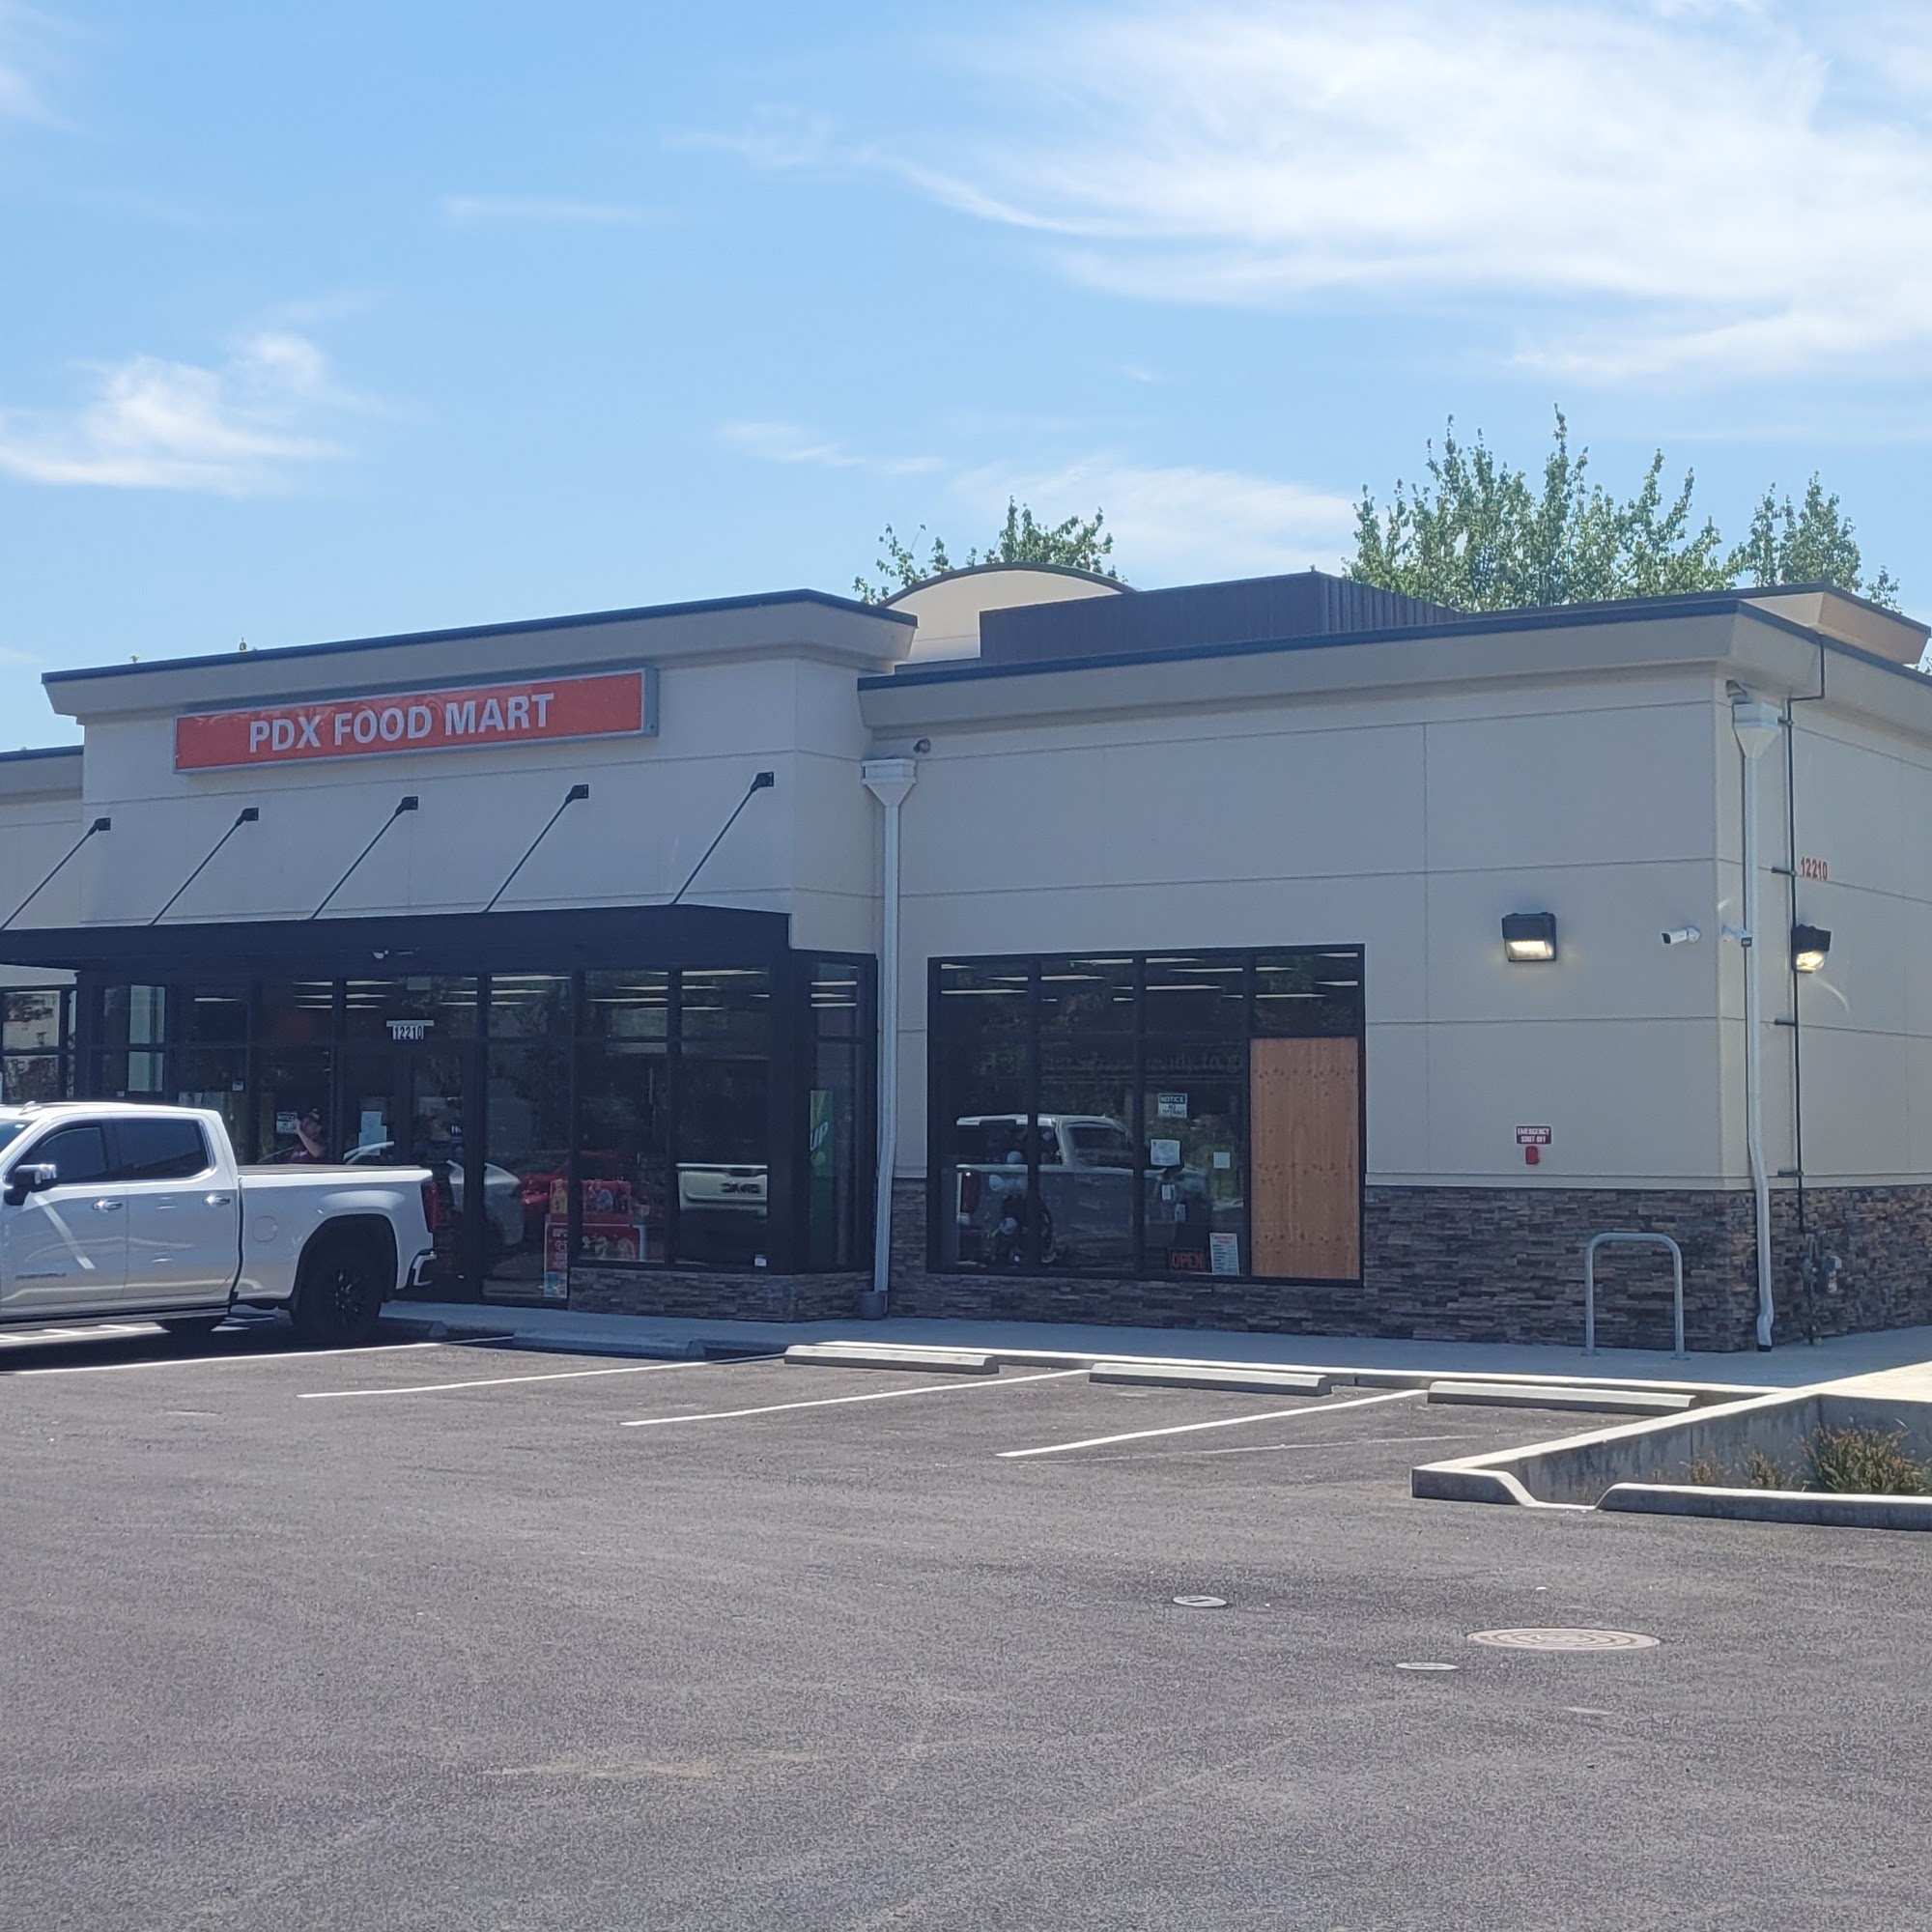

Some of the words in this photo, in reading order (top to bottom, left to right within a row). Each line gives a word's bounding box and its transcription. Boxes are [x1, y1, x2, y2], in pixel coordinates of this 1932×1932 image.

[249, 714, 322, 753] PDX
[334, 705, 432, 746] FOOD
[444, 693, 554, 736] MART
[1800, 856, 1828, 881] 12210
[394, 1025, 423, 1039] 12210
[1172, 1251, 1205, 1268] OPEN
